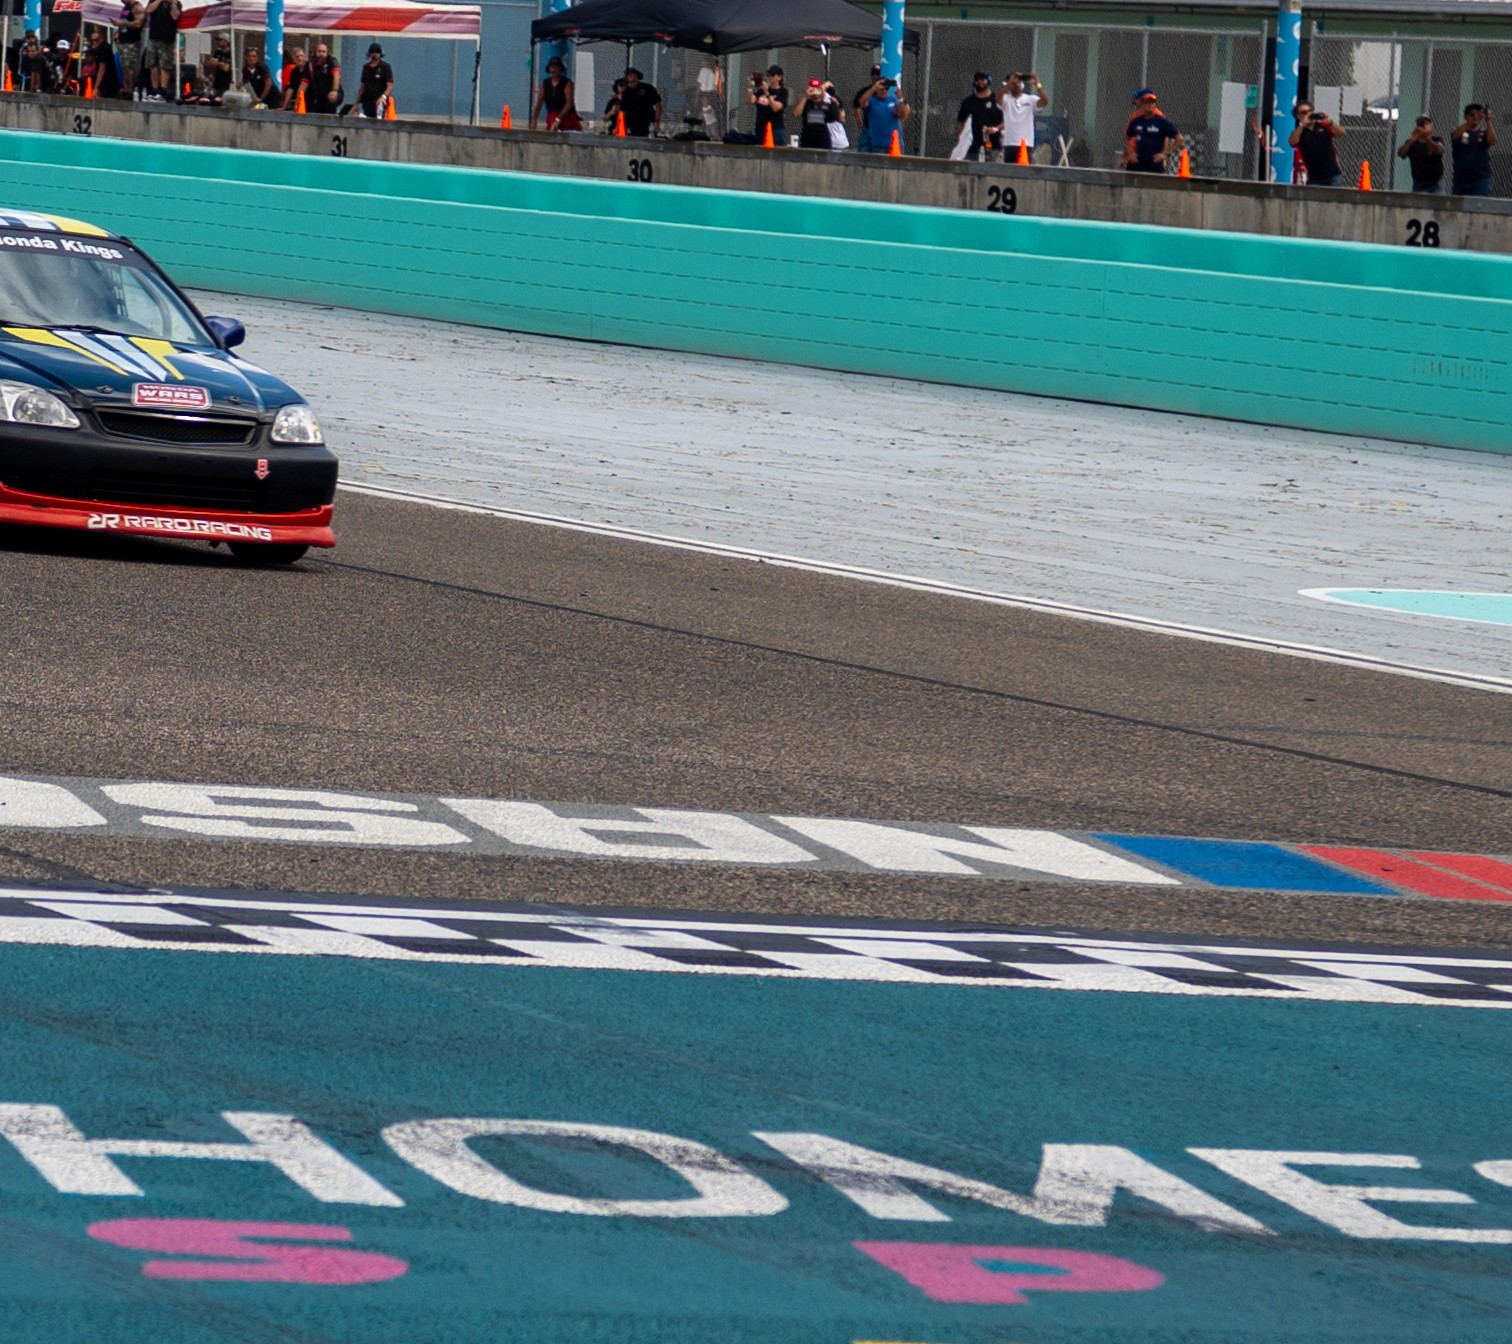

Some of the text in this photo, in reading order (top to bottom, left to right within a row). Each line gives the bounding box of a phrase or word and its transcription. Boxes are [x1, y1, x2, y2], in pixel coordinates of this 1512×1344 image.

[73, 114, 92, 137] 32
[331, 134, 348, 158] 31
[626, 159, 653, 183] 30
[986, 185, 1017, 215] 29
[1405, 218, 1441, 248] 28
[61, 239, 124, 260] Kings
[138, 389, 204, 400] WARS
[125, 515, 192, 531] RARO
[193, 519, 273, 541] RACING
